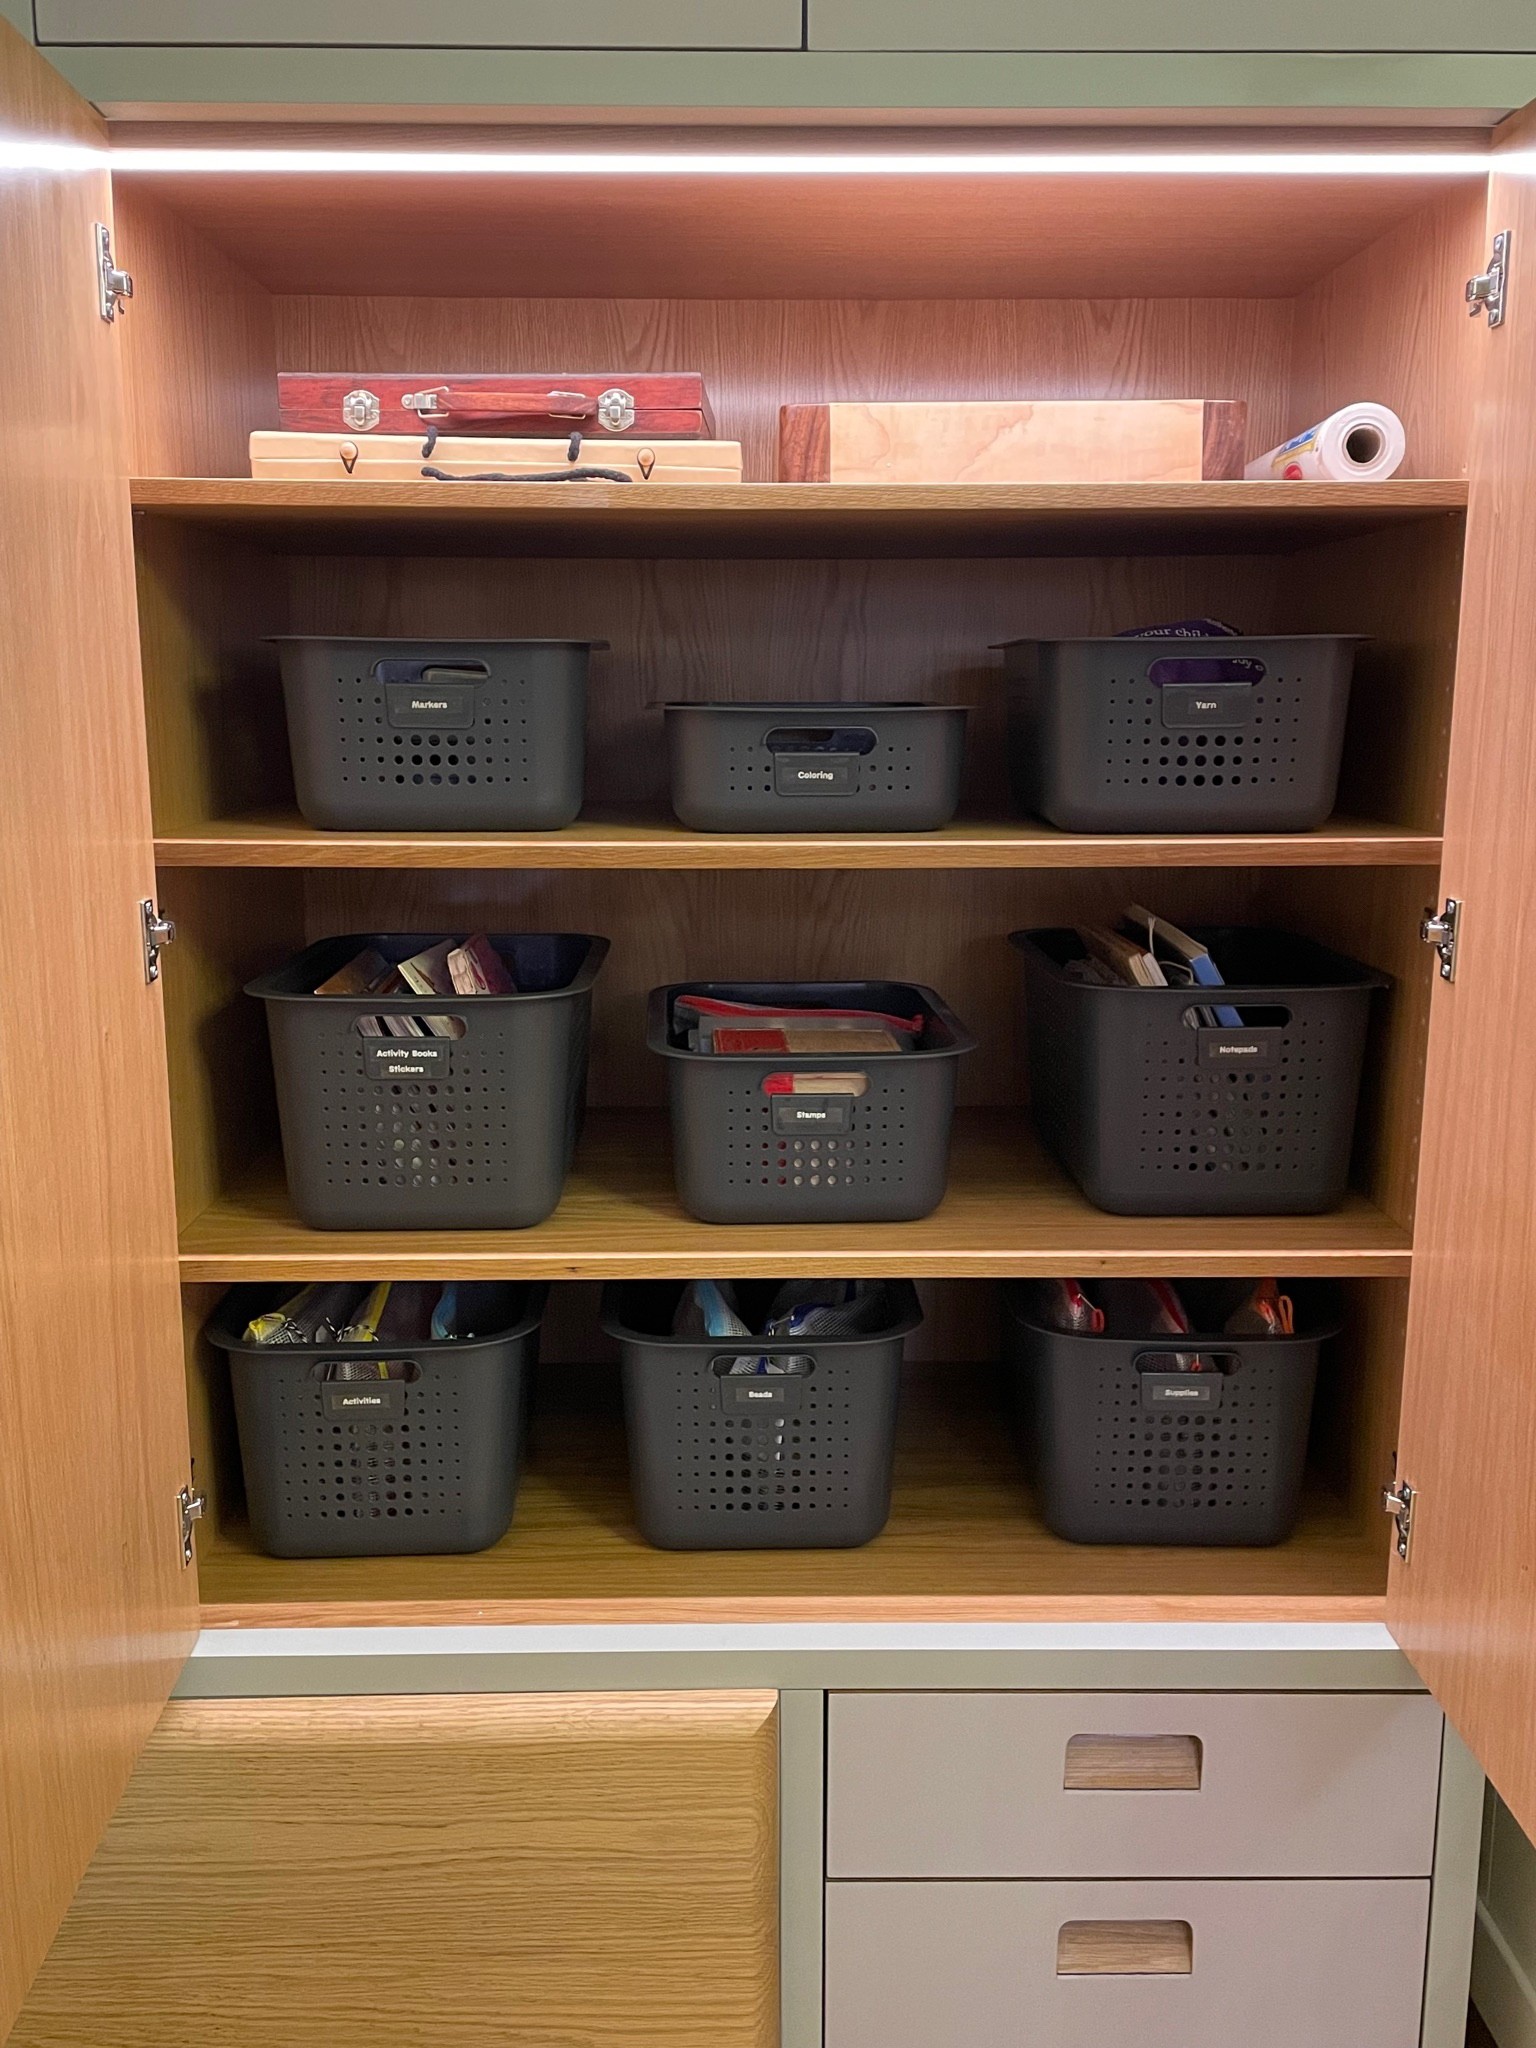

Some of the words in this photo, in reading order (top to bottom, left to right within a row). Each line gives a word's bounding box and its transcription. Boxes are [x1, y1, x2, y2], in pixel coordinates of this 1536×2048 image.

[411, 700, 448, 709] Markers
[1195, 701, 1217, 710] Yarn
[797, 771, 834, 781] Coloring
[376, 1049, 409, 1059] Activity
[412, 1049, 438, 1058] Books
[1219, 1045, 1258, 1054] Notepads
[388, 1065, 425, 1073] Stickers
[796, 1111, 826, 1119] Stamps
[1164, 1388, 1199, 1397] Supplies
[342, 1396, 381, 1405] Activities
